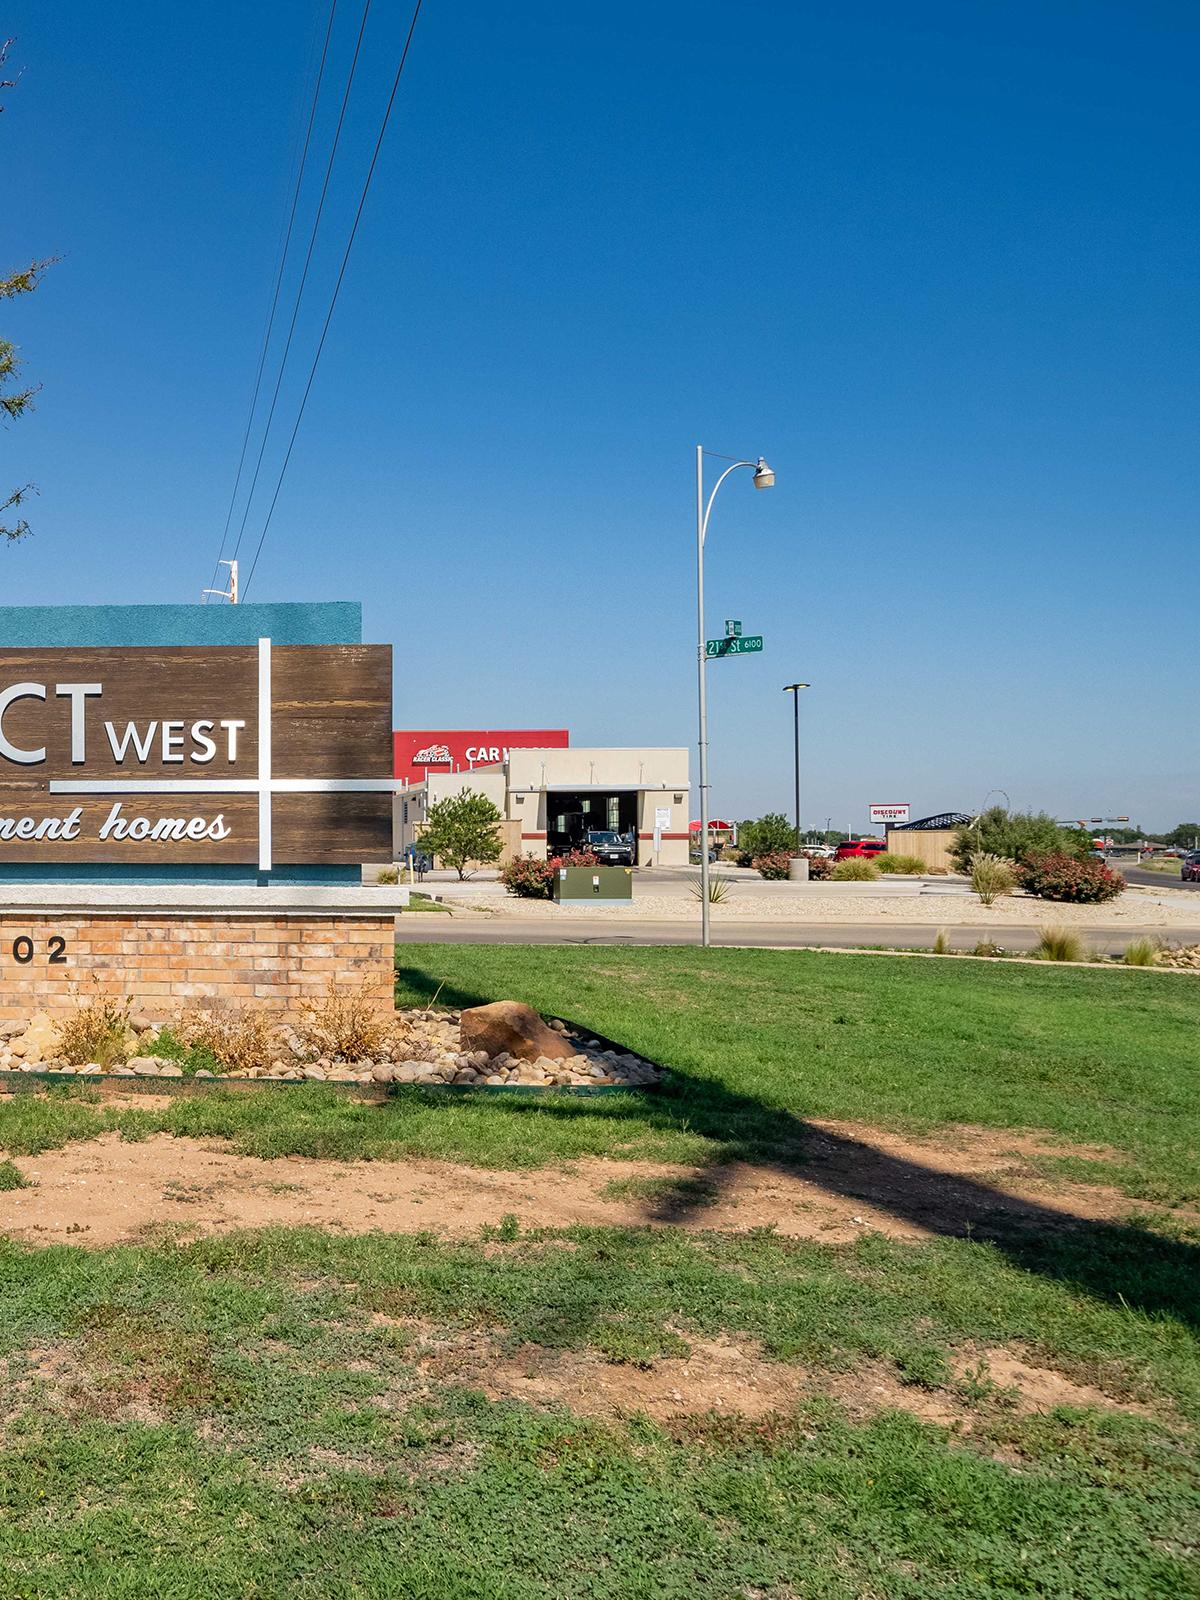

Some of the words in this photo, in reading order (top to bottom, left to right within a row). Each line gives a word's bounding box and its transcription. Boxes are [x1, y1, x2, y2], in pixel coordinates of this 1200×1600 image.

[730, 640, 741, 652] St
[744, 639, 762, 648] 6100
[104, 720, 245, 763] WEST
[465, 747, 500, 761] CAR
[99, 802, 232, 842] homes
